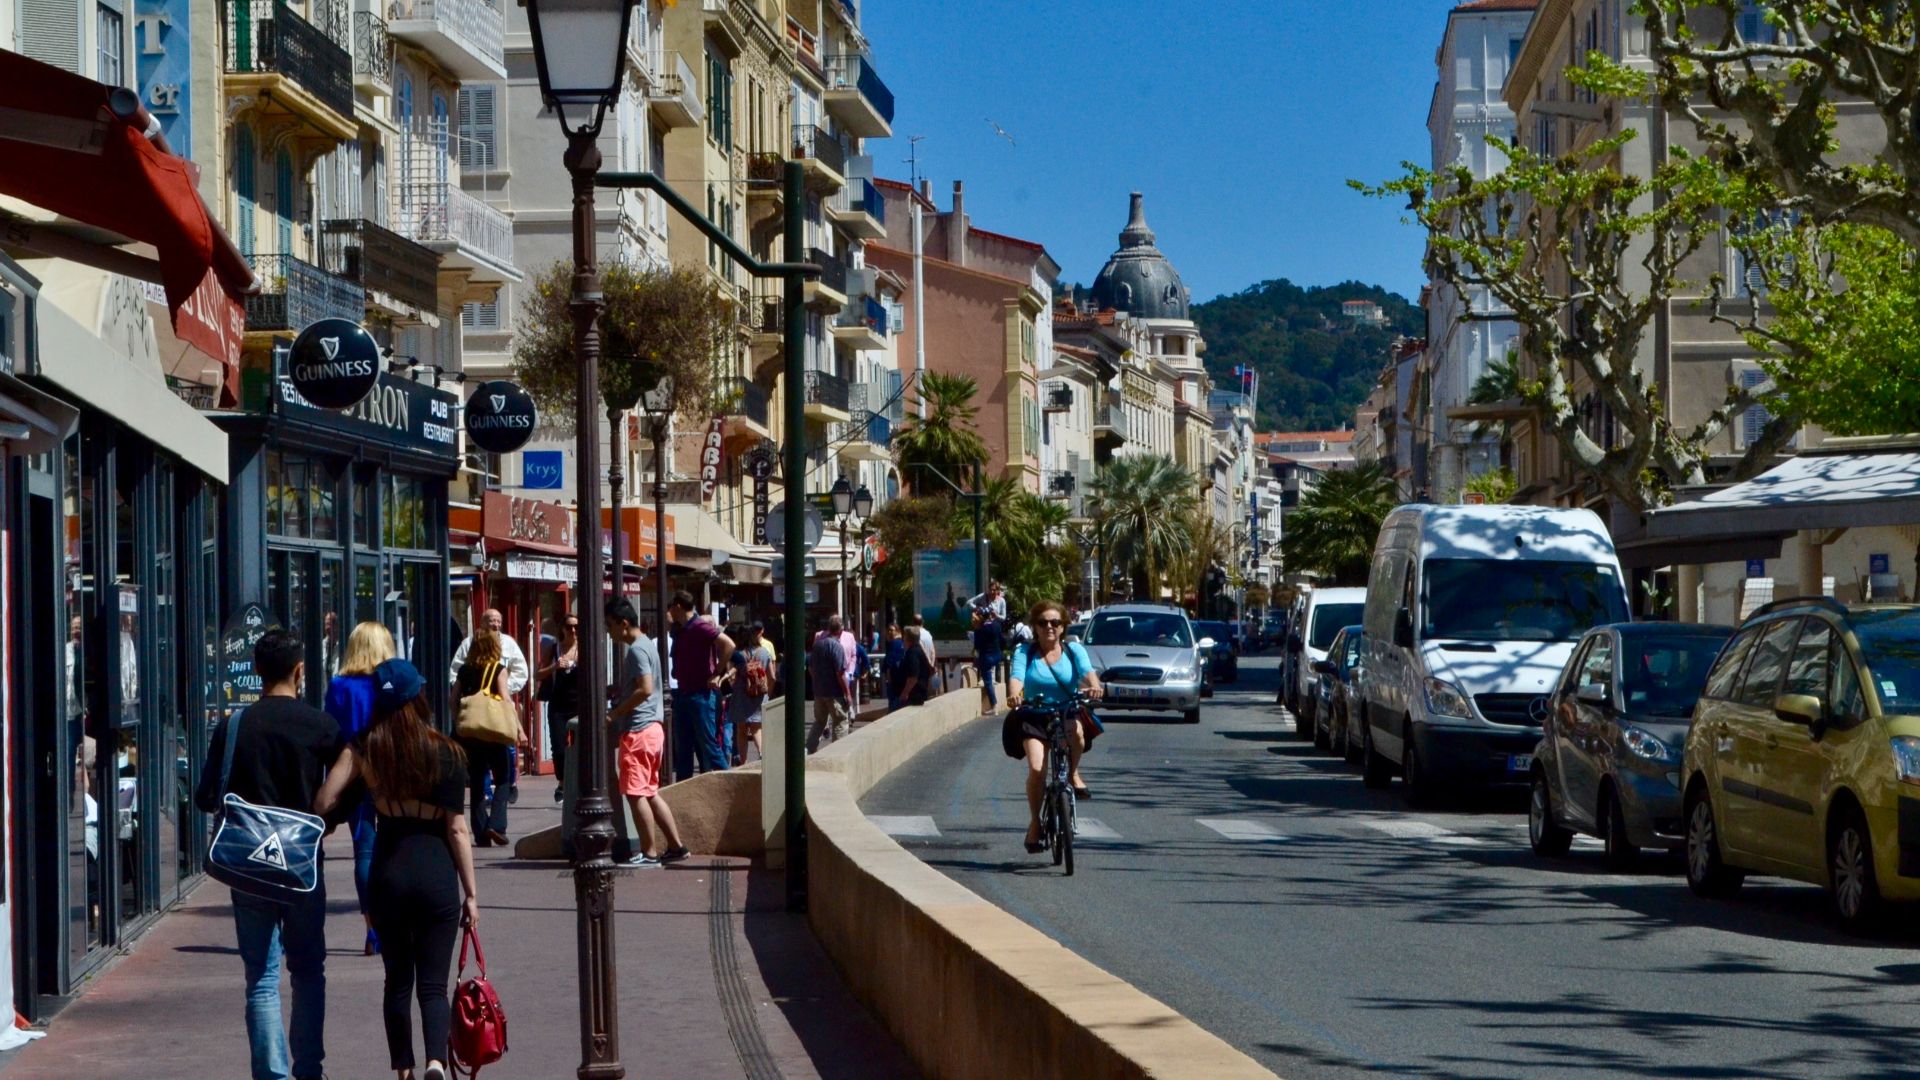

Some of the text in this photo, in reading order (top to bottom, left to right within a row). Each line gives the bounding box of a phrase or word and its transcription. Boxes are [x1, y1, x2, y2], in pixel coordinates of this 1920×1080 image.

[295, 360, 372, 381] GUINNESS
[341, 383, 409, 432] RON
[431, 399, 448, 419] PUB
[469, 413, 530, 431] GUINNESS
[423, 421, 455, 445] RESTAURANT
[702, 418, 722, 496] TABAC
[526, 463, 557, 479] Krys
